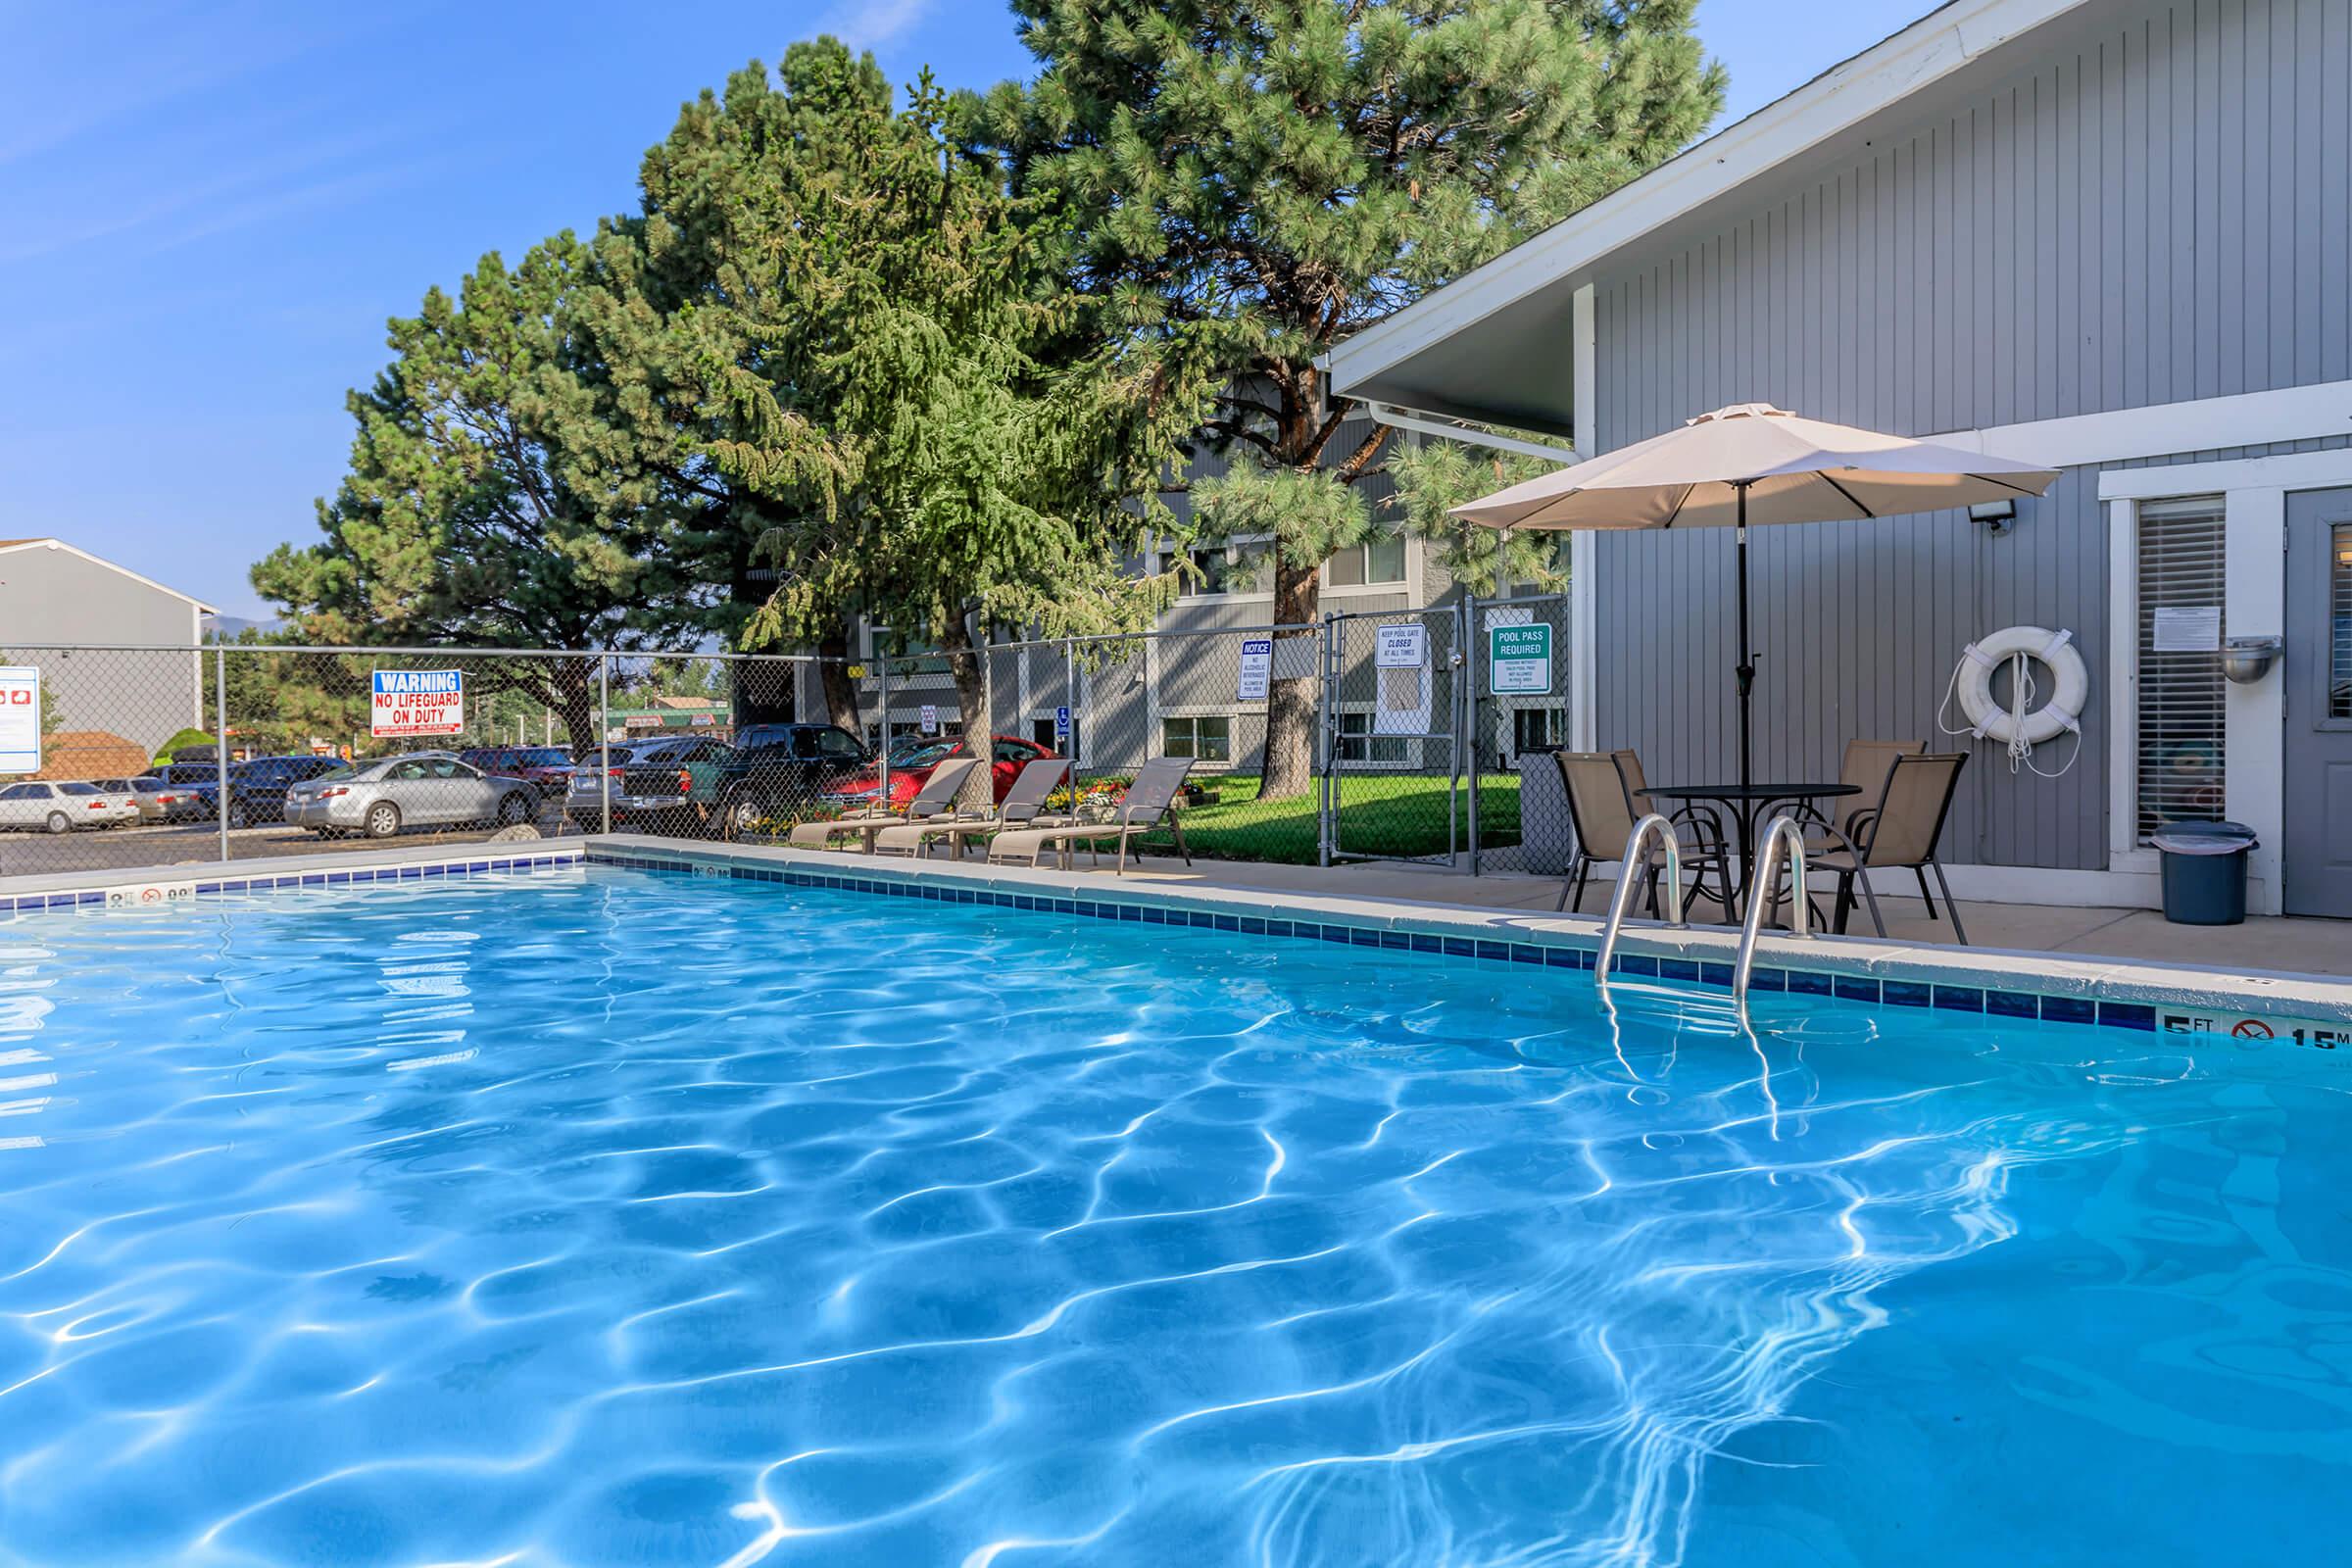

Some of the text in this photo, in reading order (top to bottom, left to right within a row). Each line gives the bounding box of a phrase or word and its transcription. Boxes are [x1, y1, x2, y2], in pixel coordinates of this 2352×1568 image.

[1499, 631, 1543, 642] POOL PASS
[1244, 643, 1269, 654] NOTICE
[1388, 639, 1412, 648] CLOSED
[1500, 644, 1542, 655] REQUIRED
[381, 673, 457, 692] WARNING
[375, 692, 460, 708] NO LIFEGUARD
[393, 709, 445, 724] ON DUTY
